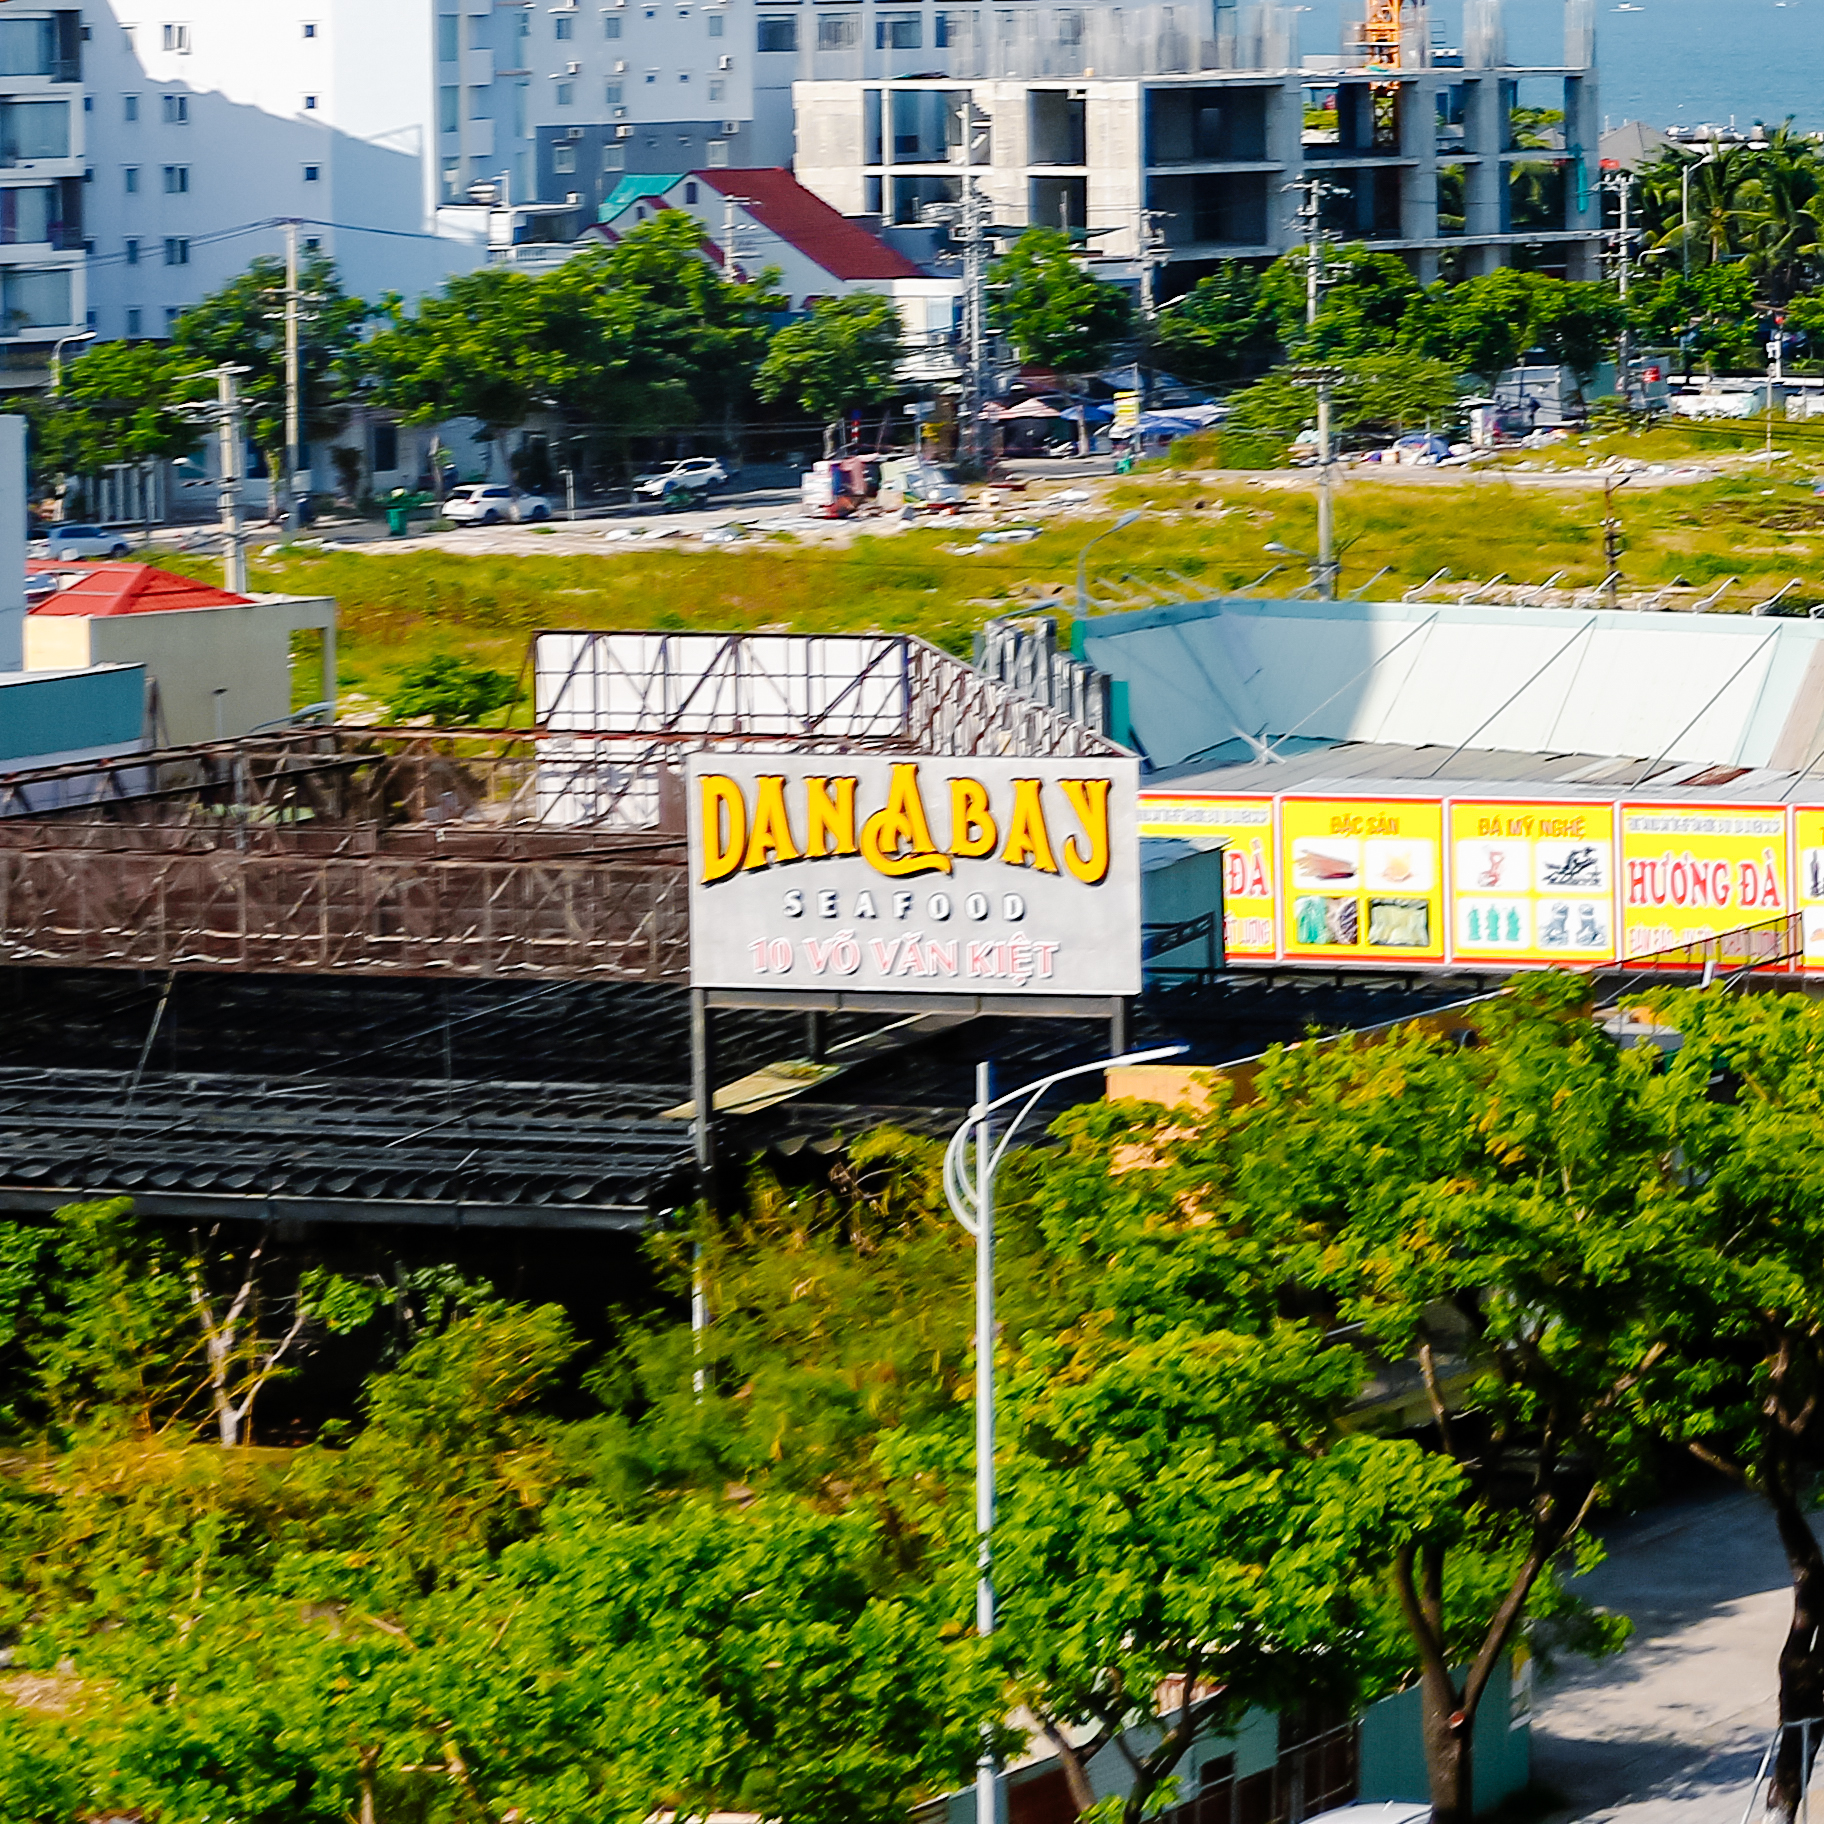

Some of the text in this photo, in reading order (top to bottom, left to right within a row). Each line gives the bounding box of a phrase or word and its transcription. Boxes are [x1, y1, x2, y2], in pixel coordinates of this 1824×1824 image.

[699, 762, 1112, 886] DANABAY
[782, 887, 1026, 923] SEAFOOD
[1627, 847, 1782, 909] HƯƠNG ĐÀ
[749, 936, 794, 975] 10
[966, 930, 1061, 987] KIỆT
